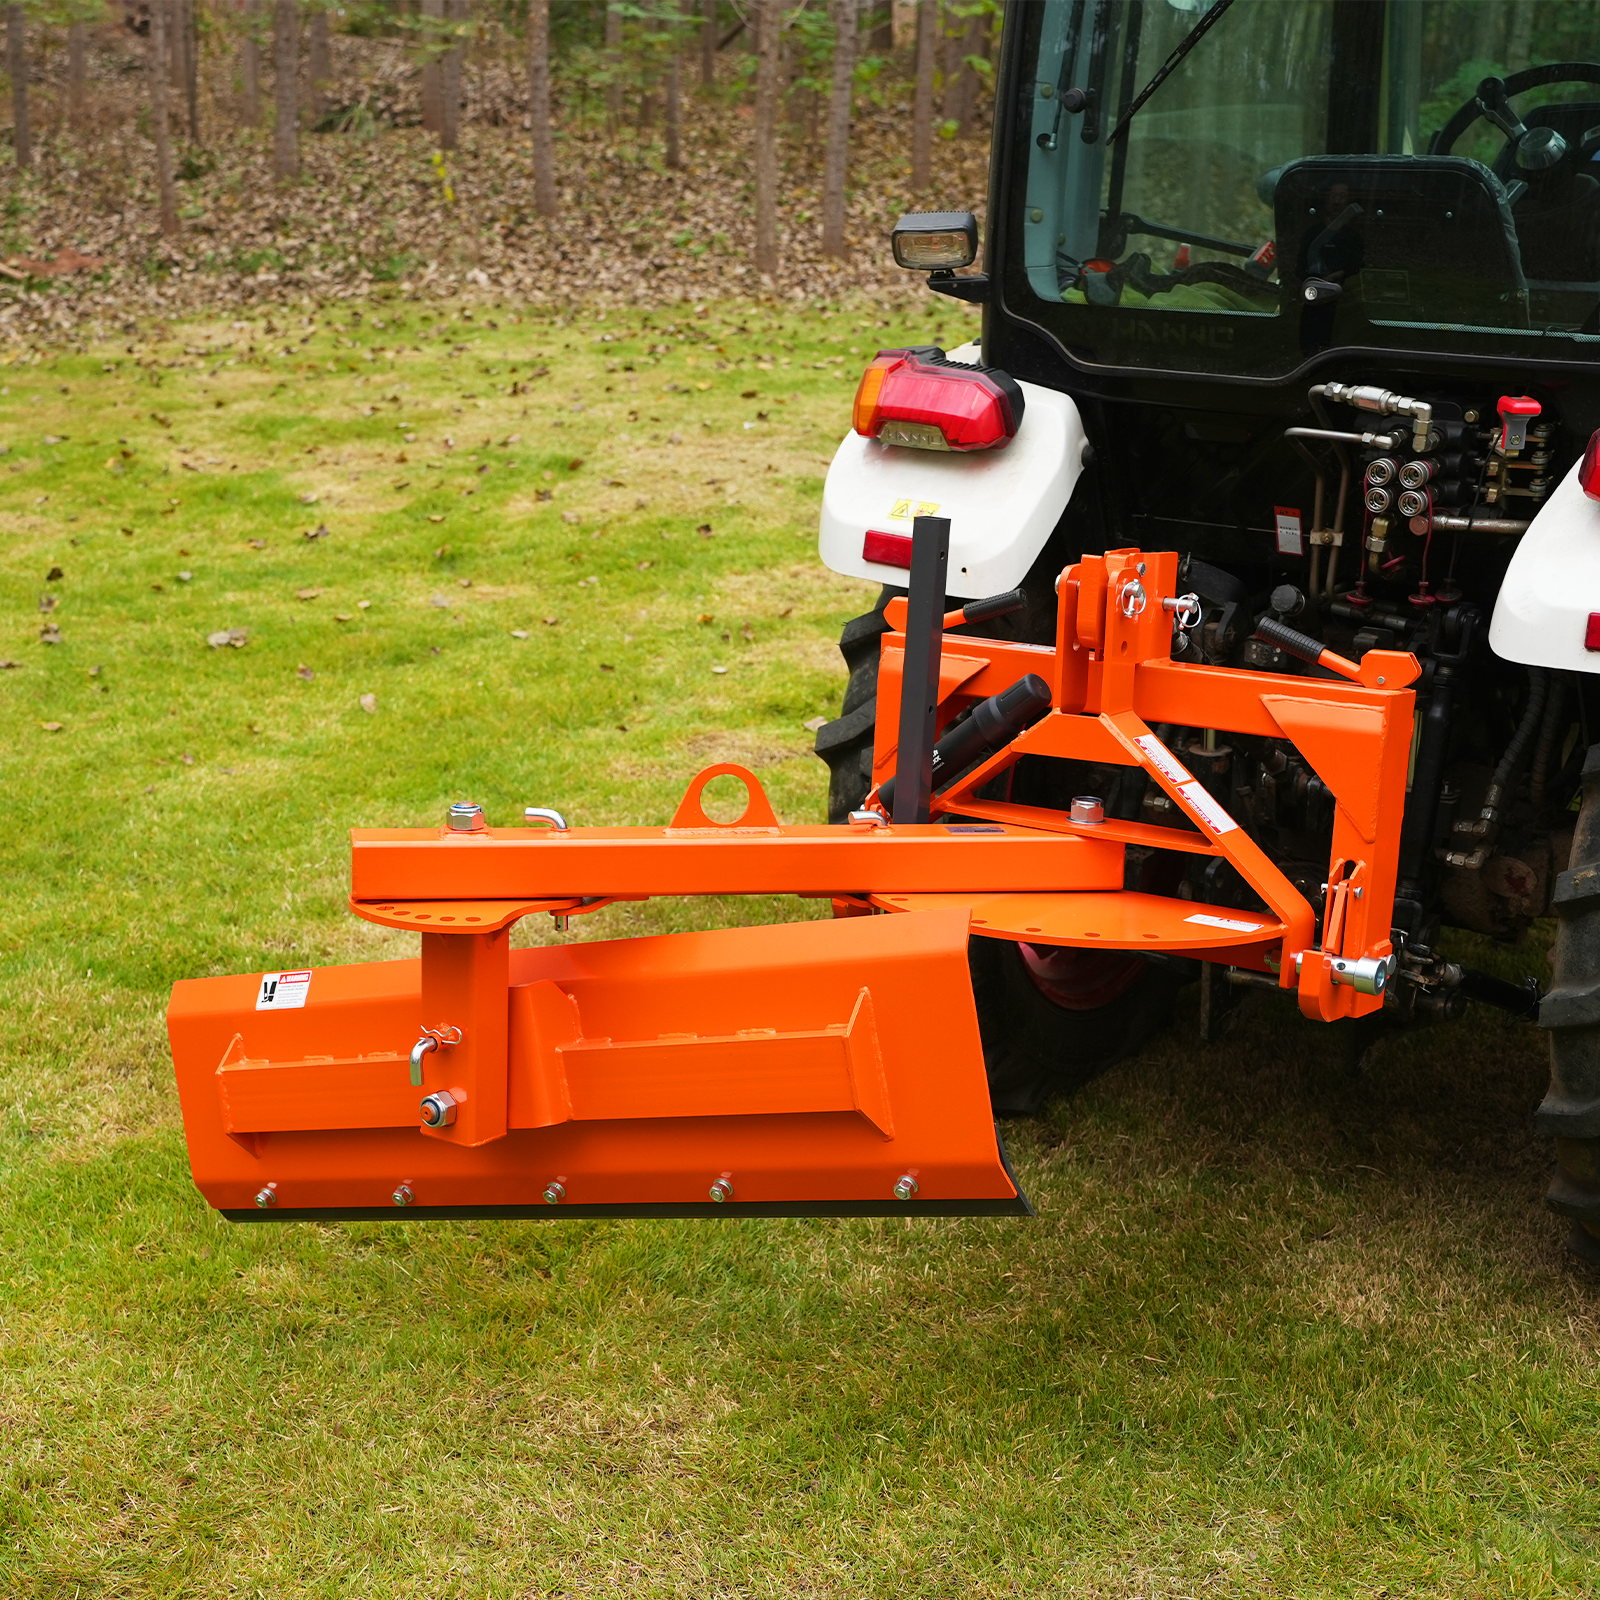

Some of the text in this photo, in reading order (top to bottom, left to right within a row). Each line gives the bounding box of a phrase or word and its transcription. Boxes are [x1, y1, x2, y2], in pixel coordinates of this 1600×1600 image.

[1112, 317, 1235, 349] HANNO
[886, 429, 943, 446] HANNO
[287, 974, 309, 982] WARNING
